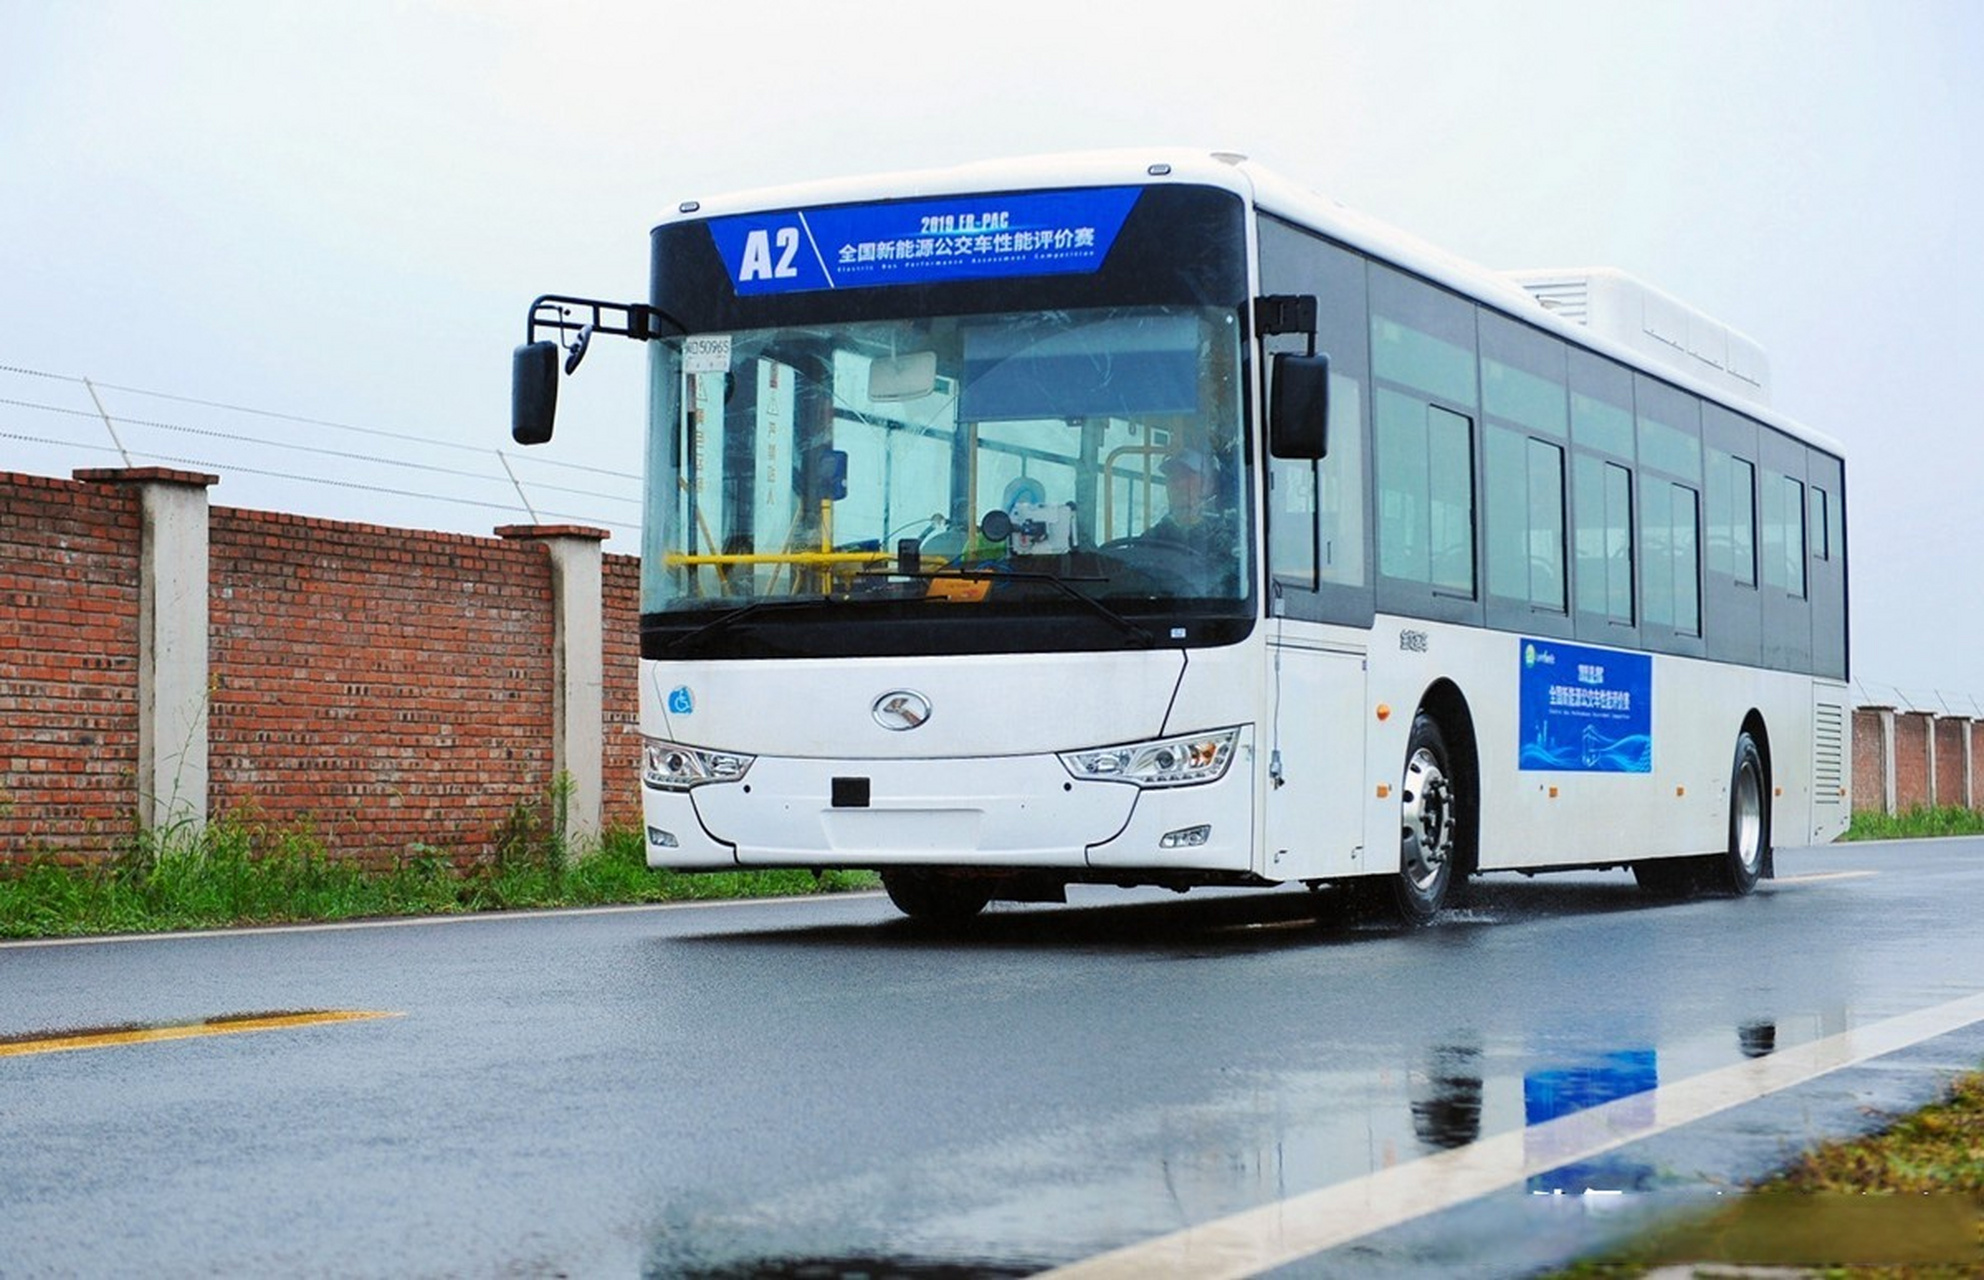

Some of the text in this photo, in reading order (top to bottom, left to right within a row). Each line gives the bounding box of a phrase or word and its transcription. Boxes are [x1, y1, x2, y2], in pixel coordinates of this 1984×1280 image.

[921, 214, 954, 233] 2019
[739, 227, 799, 281] A2
[838, 227, 1095, 263] 全国新能源公交车性能评价赛
